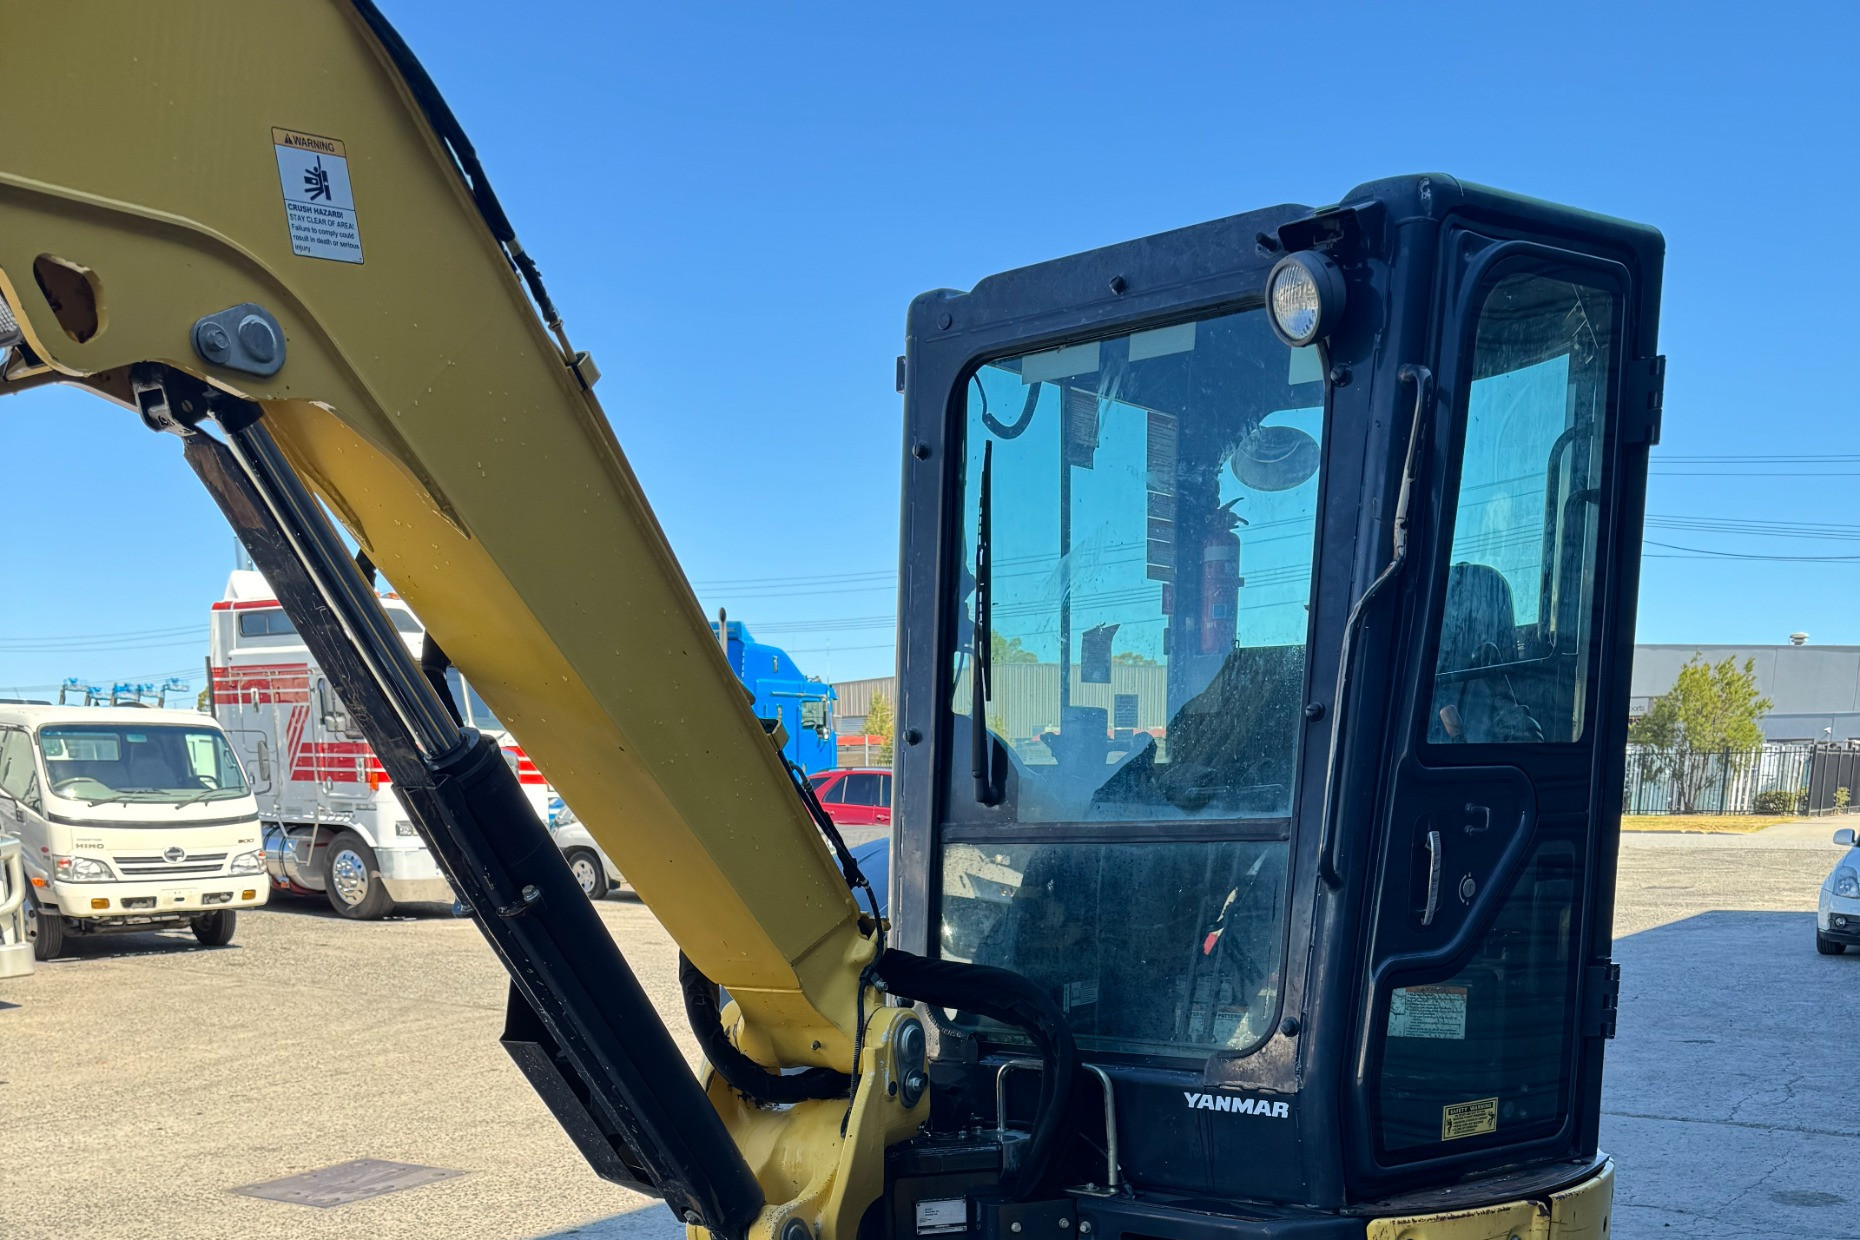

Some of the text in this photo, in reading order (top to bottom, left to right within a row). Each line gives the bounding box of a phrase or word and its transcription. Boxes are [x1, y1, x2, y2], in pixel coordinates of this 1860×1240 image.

[292, 135, 335, 152] WARNING
[287, 203, 312, 214] CRUSH
[289, 213, 305, 222] STAY
[306, 216, 327, 226] CLEAR
[327, 219, 336, 227] OF
[291, 223, 355, 240] Failure to comply could
[293, 234, 309, 242] result
[310, 235, 316, 243] in
[316, 238, 333, 246] death
[339, 241, 360, 250] serious
[1183, 1091, 1290, 1118] YANMAR
